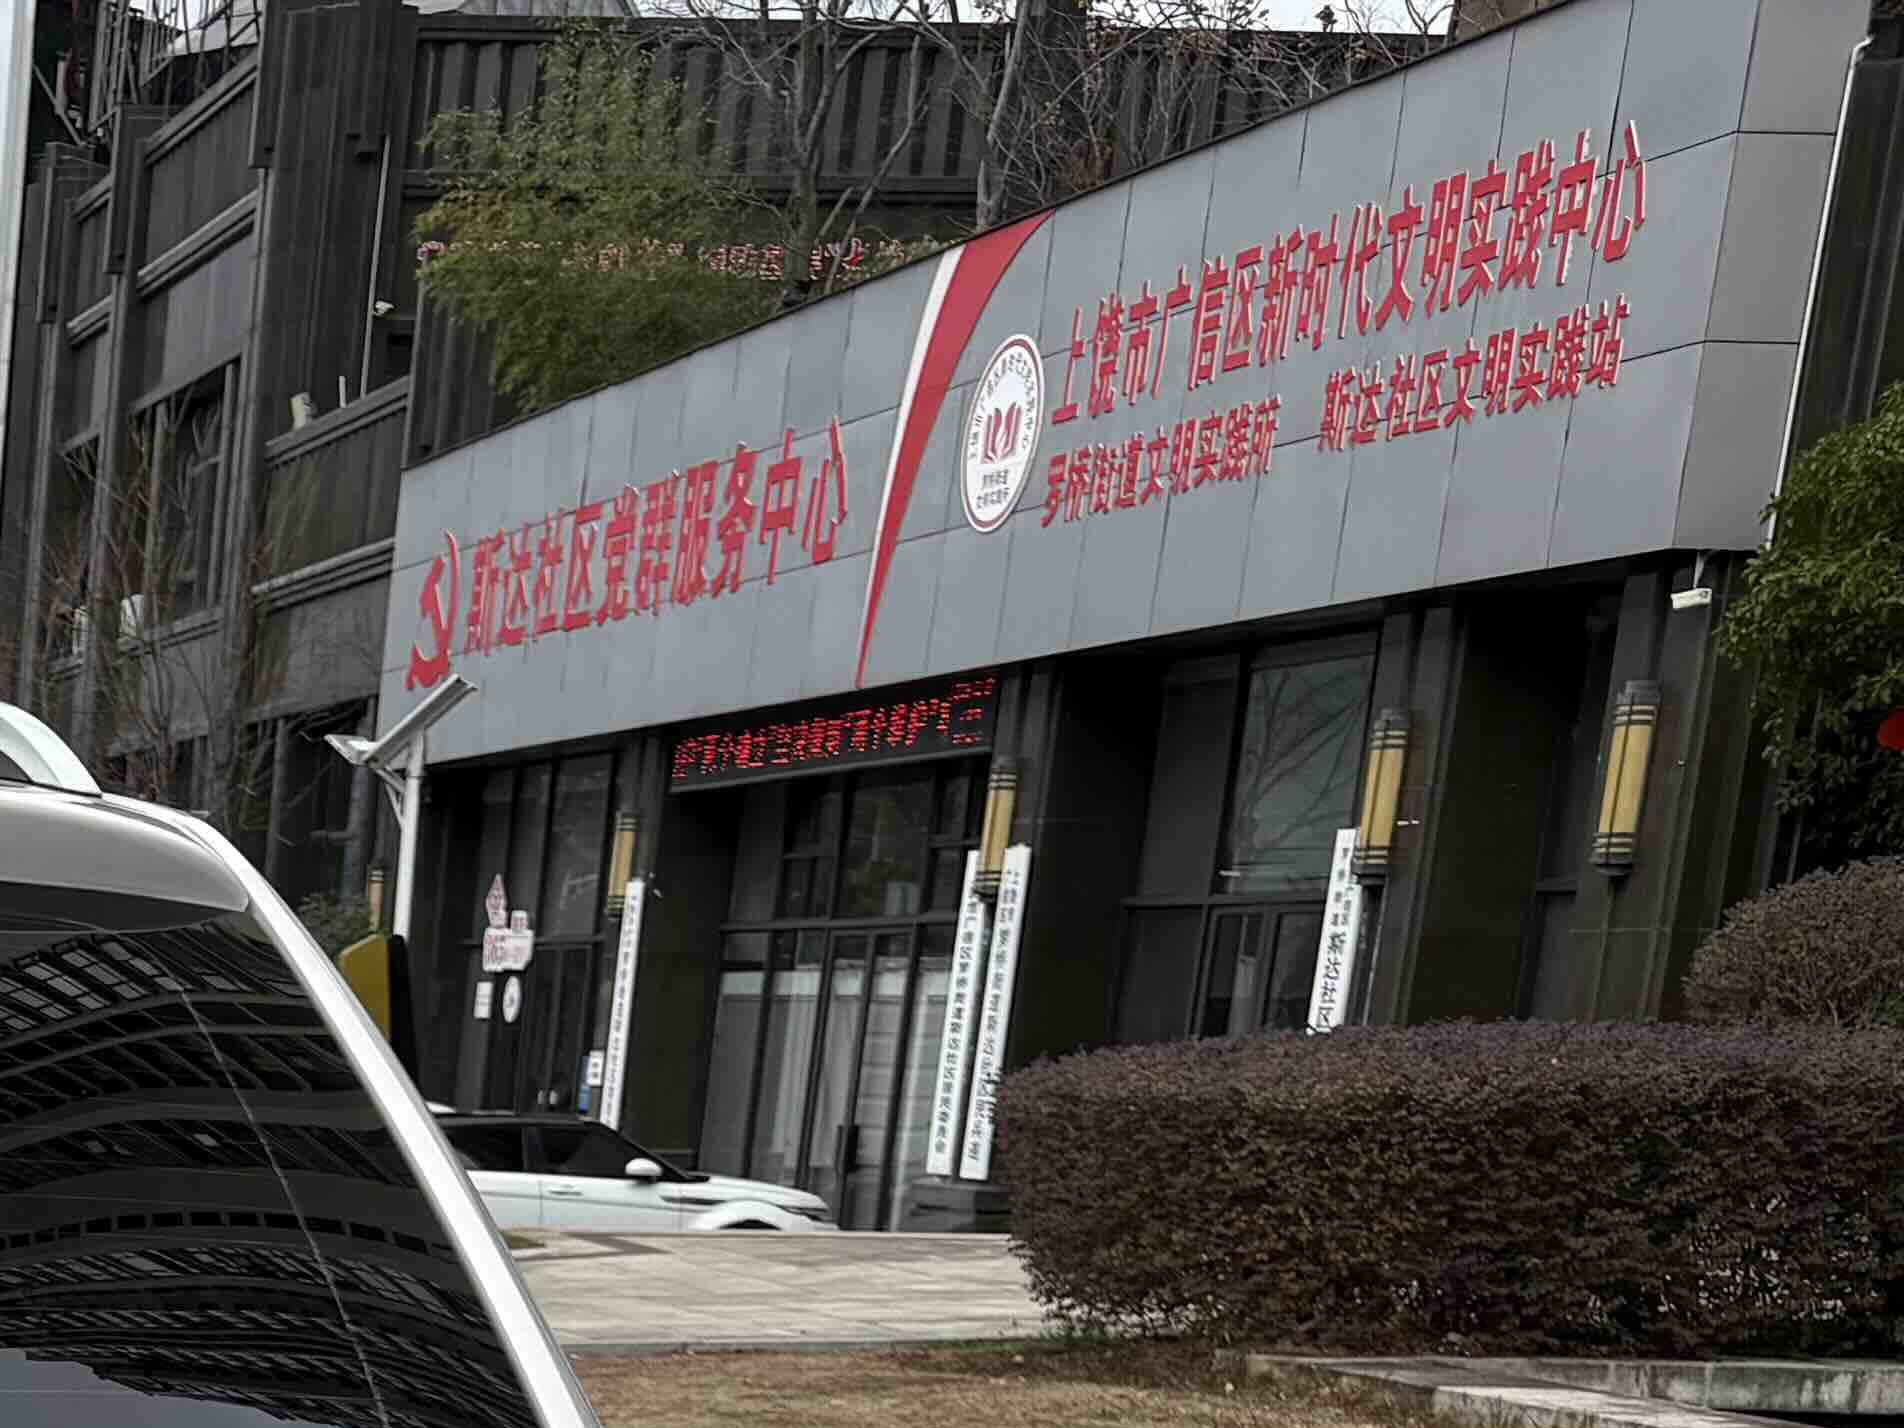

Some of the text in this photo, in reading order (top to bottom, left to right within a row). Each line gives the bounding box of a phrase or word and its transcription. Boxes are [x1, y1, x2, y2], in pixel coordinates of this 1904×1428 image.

[1052, 120, 1648, 425] 上饶市广信区新时代文明实践中心
[1040, 392, 1282, 528] 罗桥街道文明实践所
[1318, 294, 1631, 453] 斯达社区文明实践站
[464, 415, 848, 656] 斯达社区党群服务中心
